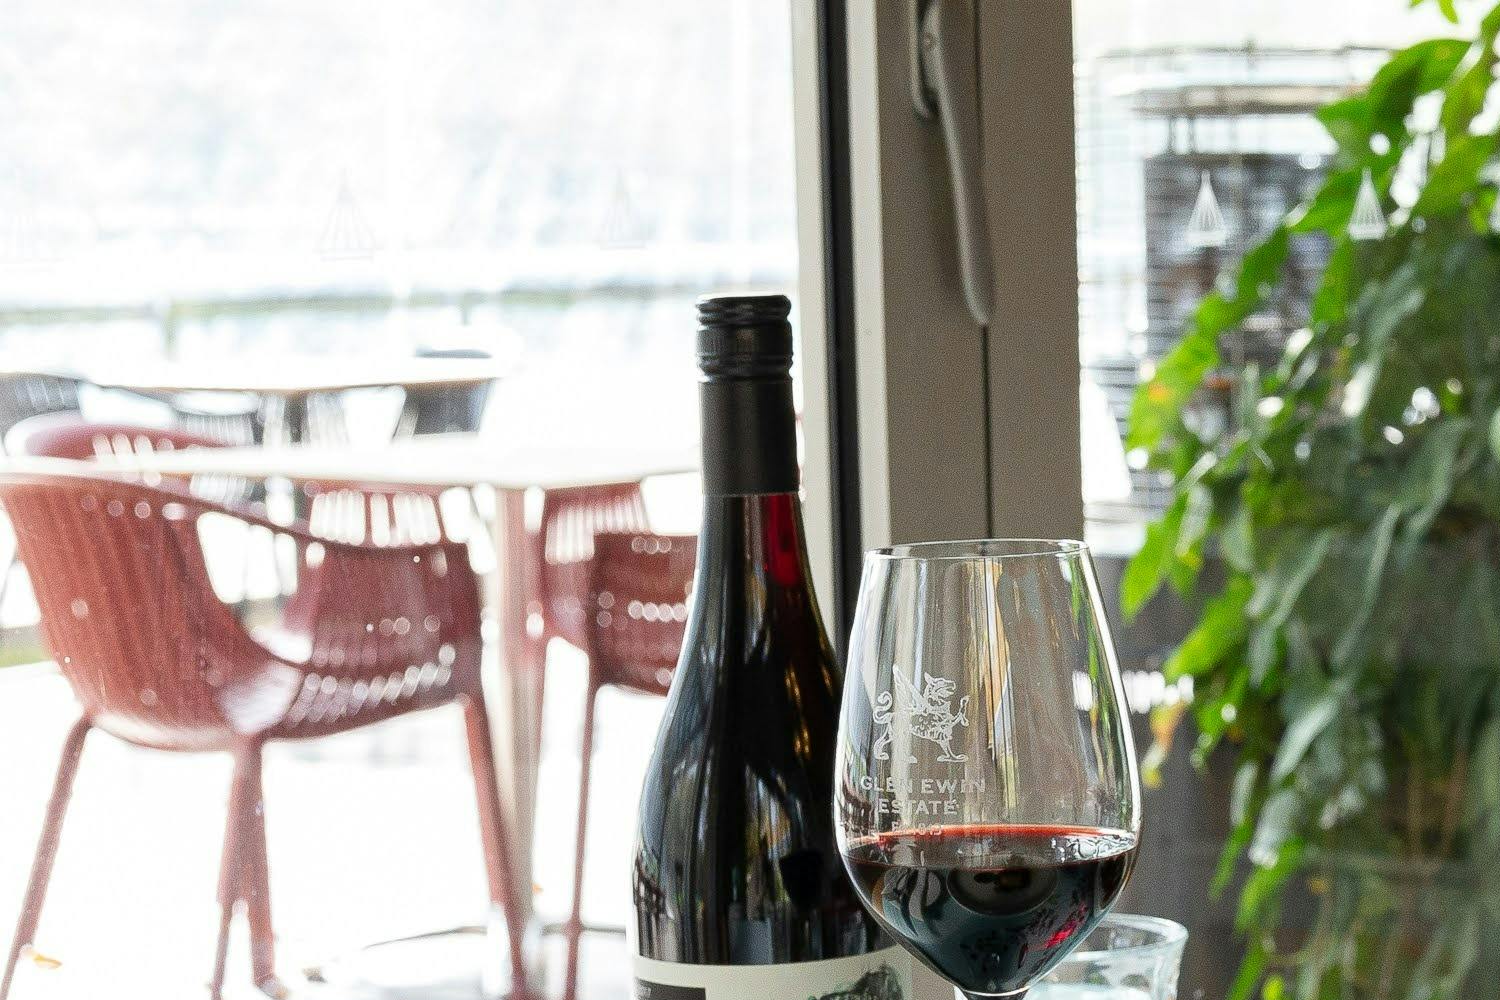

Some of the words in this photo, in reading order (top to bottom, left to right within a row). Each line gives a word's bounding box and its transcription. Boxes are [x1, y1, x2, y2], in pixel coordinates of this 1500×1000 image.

[860, 775, 913, 794] GLEN
[921, 778, 986, 794] EWIN
[878, 798, 958, 815] ESTATE
